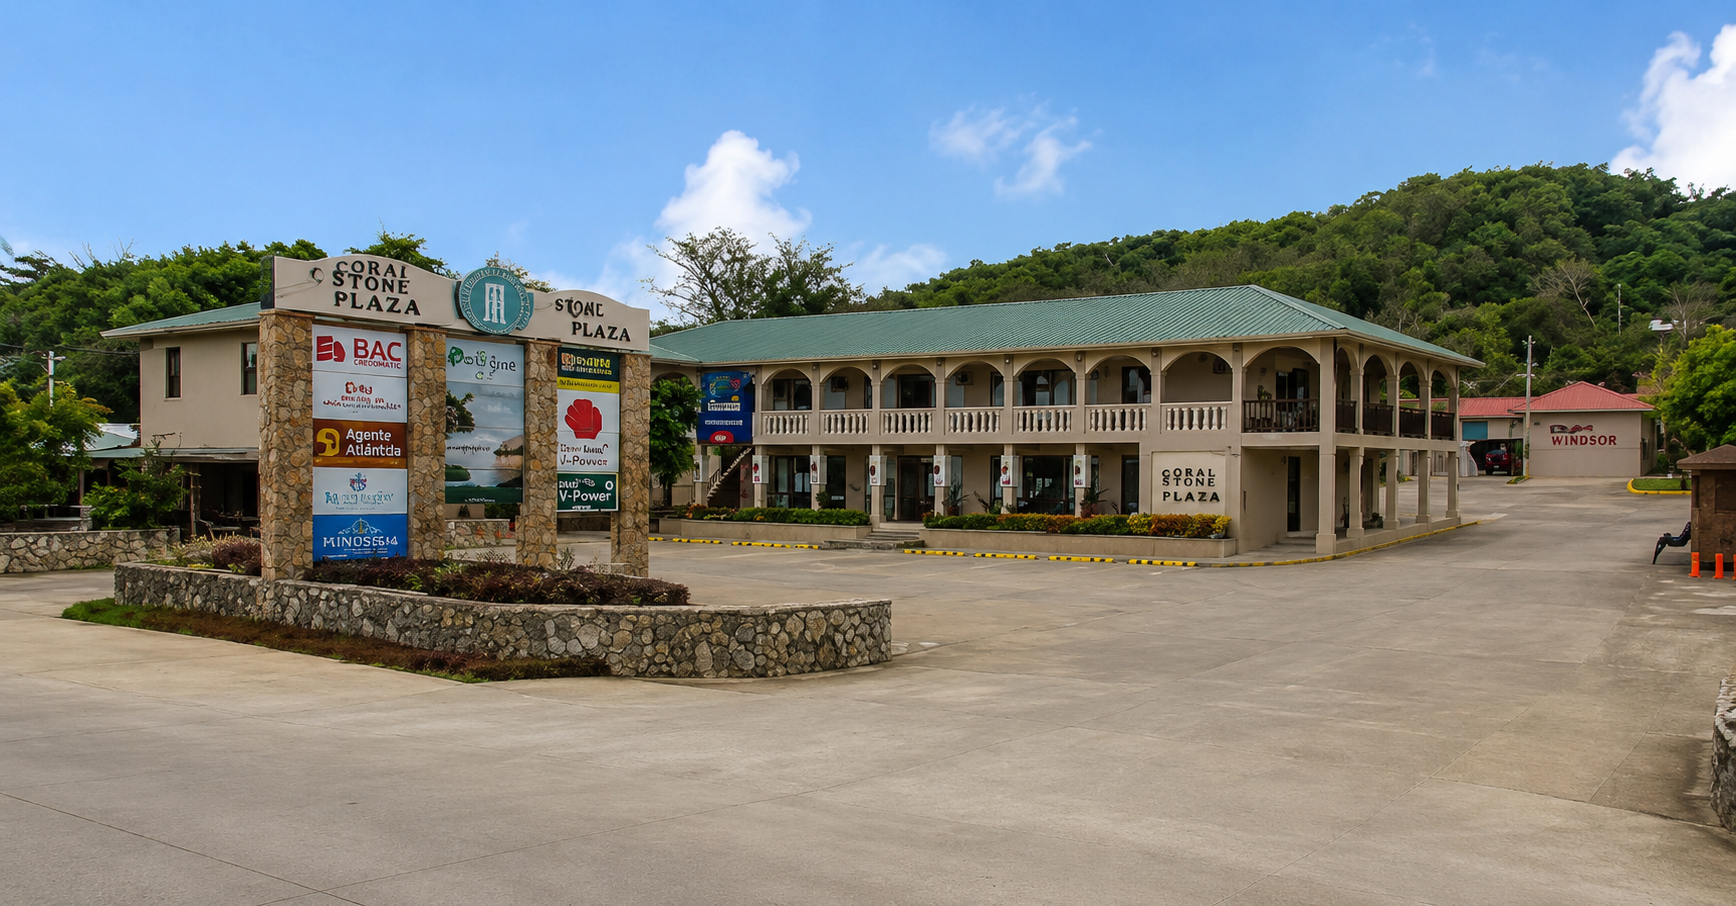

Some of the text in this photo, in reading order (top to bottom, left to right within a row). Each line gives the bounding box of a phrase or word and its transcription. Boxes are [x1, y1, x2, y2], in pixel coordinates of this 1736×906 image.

[332, 270, 410, 295] STONE
[334, 290, 421, 316] PLAZA
[571, 321, 631, 342] PLAZA
[353, 337, 402, 362] BAC
[345, 428, 392, 443] Agente
[1551, 435, 1617, 446] WINDSOR
[1161, 468, 1215, 477] CORAL
[1162, 477, 1216, 487] STONE
[558, 489, 612, 503] V-Power
[1162, 491, 1220, 502] PLAZA
